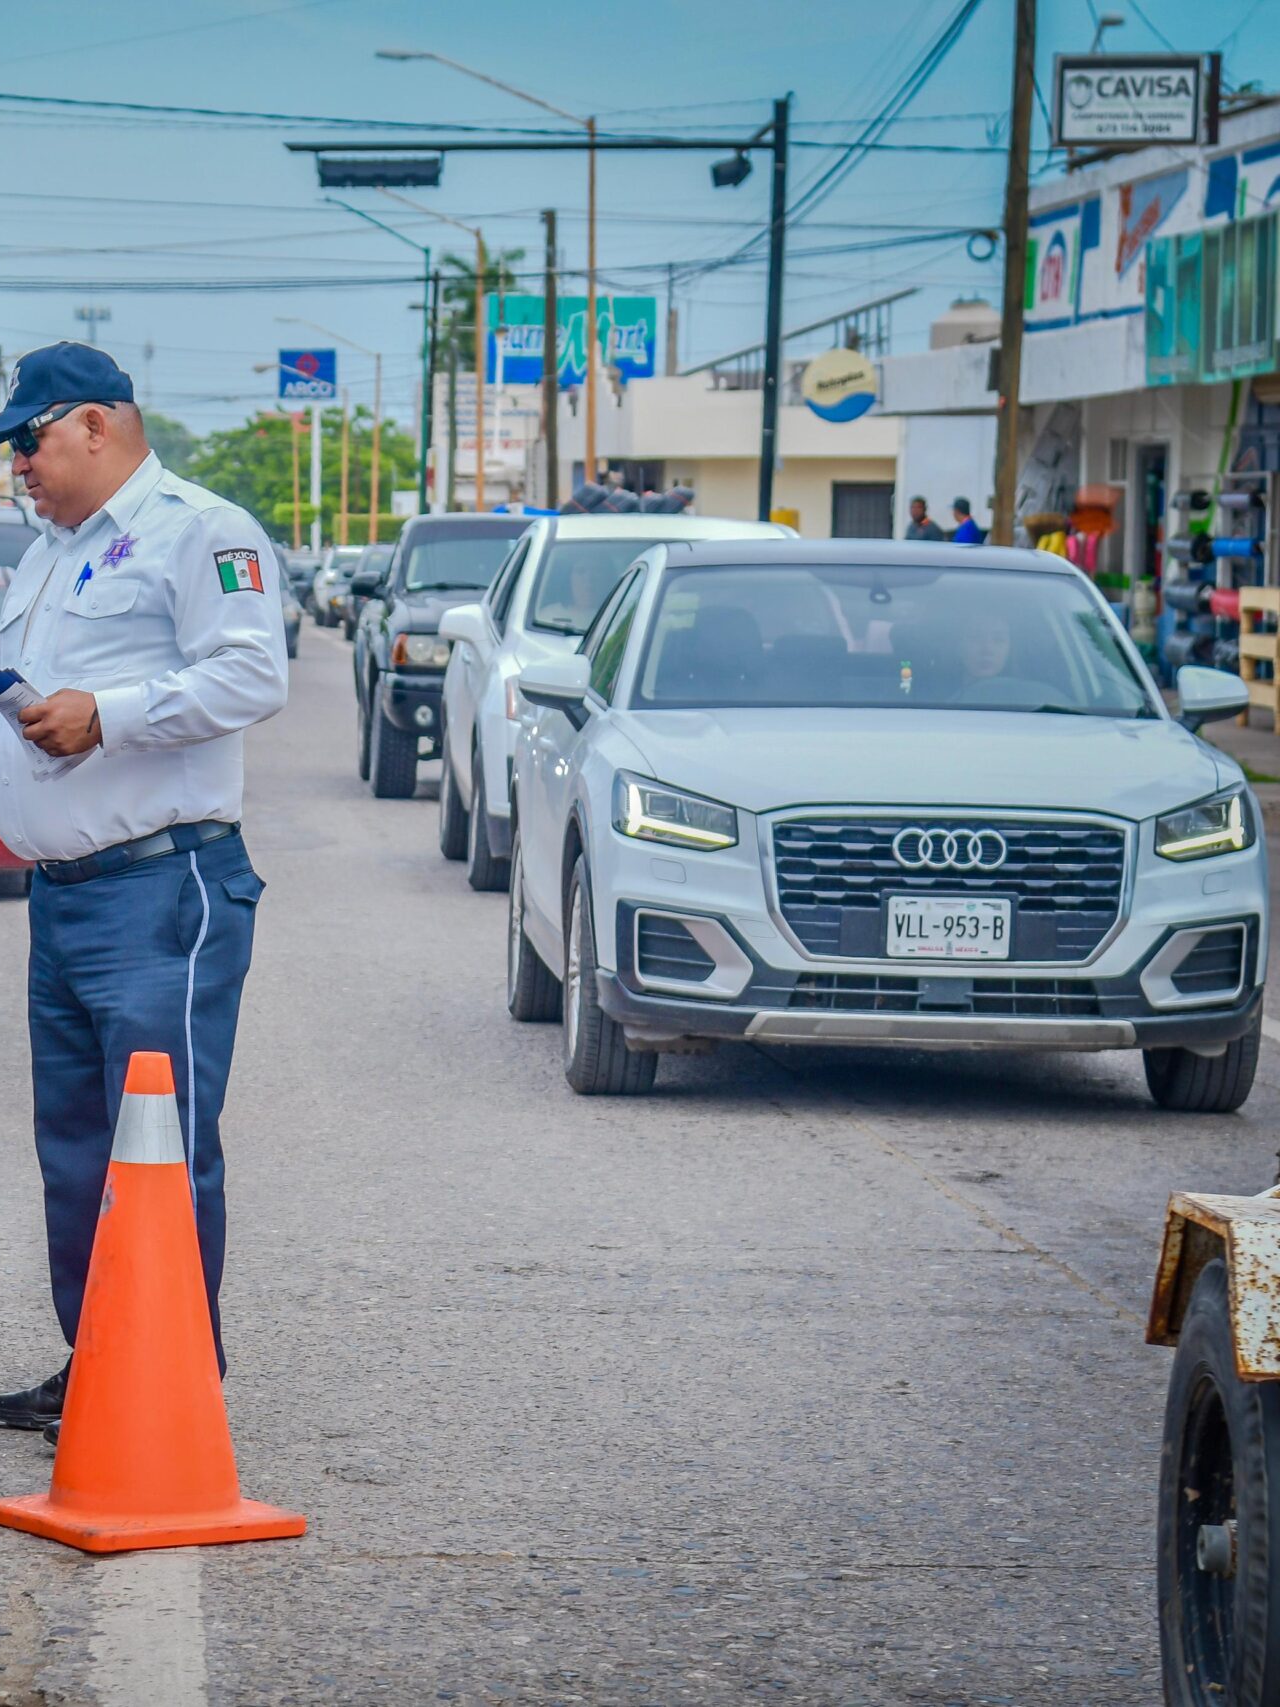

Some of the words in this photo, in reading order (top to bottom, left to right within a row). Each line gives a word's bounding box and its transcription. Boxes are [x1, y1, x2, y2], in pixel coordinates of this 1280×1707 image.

[1096, 75, 1192, 98] CAVISA
[283, 381, 333, 397] ARCO
[216, 551, 257, 564] MÉXICO
[895, 913, 1005, 940] VLL-953-B
